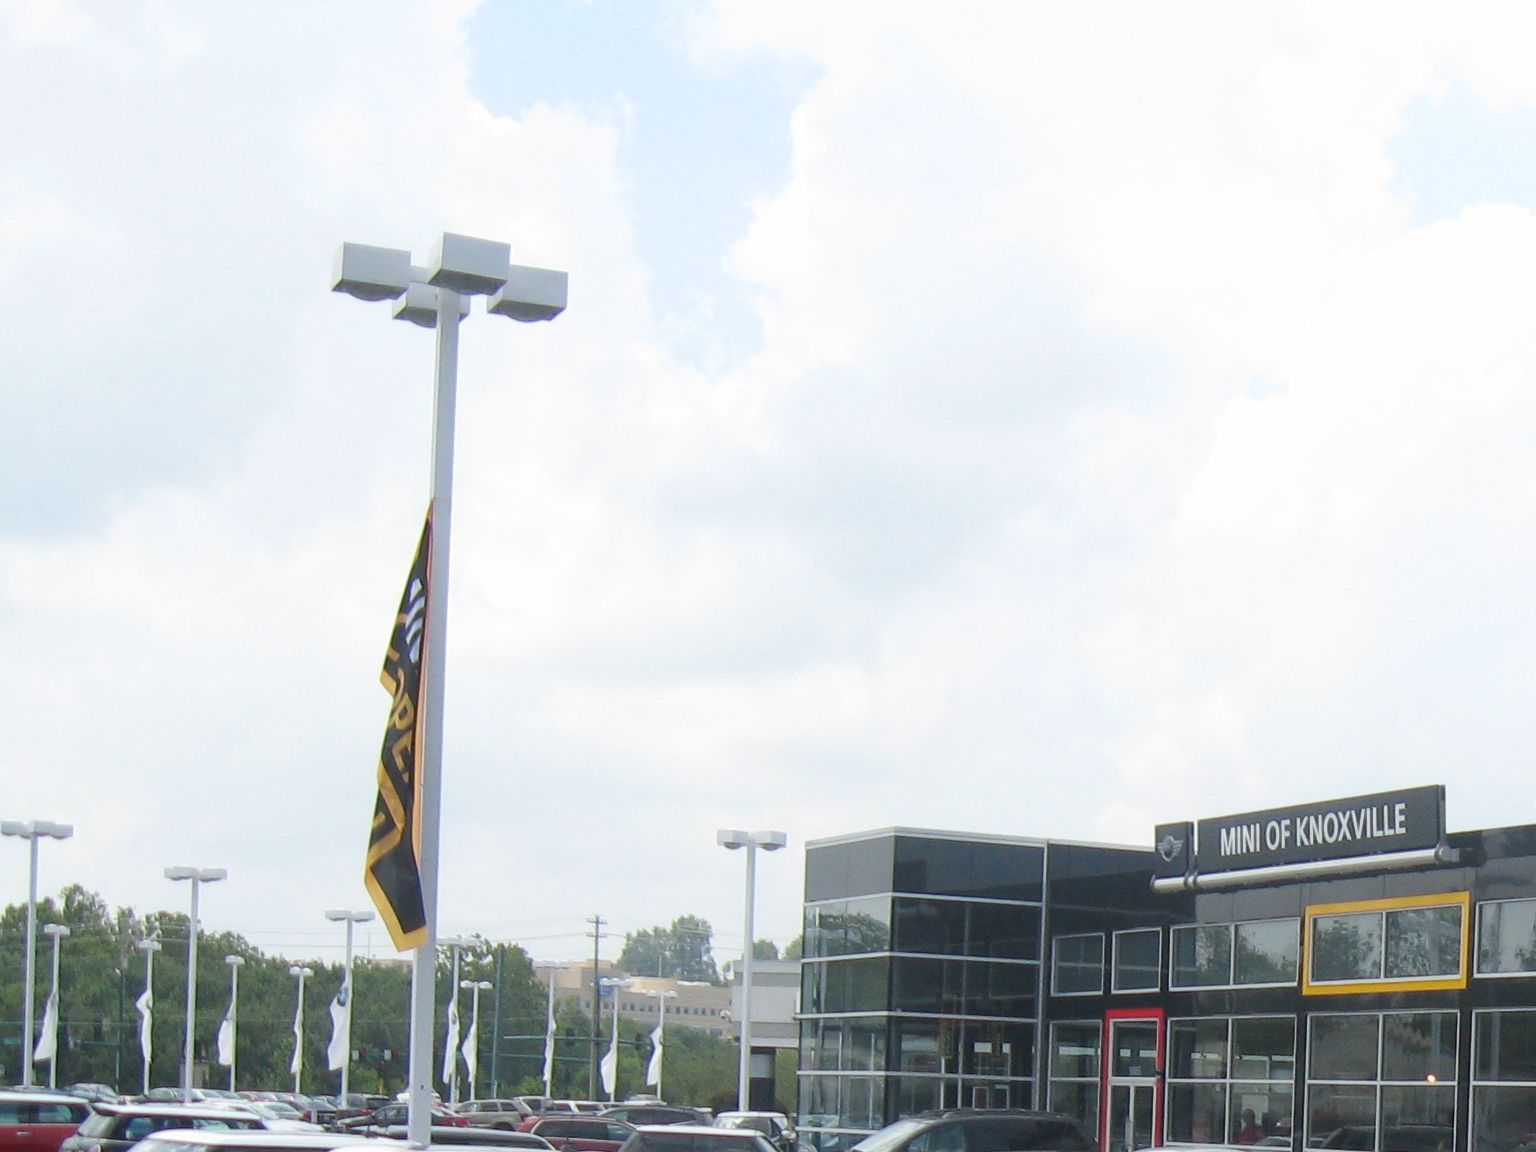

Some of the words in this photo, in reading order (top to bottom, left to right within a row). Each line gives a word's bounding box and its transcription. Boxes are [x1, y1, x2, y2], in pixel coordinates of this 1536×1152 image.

[1220, 823, 1261, 857] MINI
[1265, 819, 1291, 851] OF
[1296, 803, 1407, 847] KNOXVILLE
